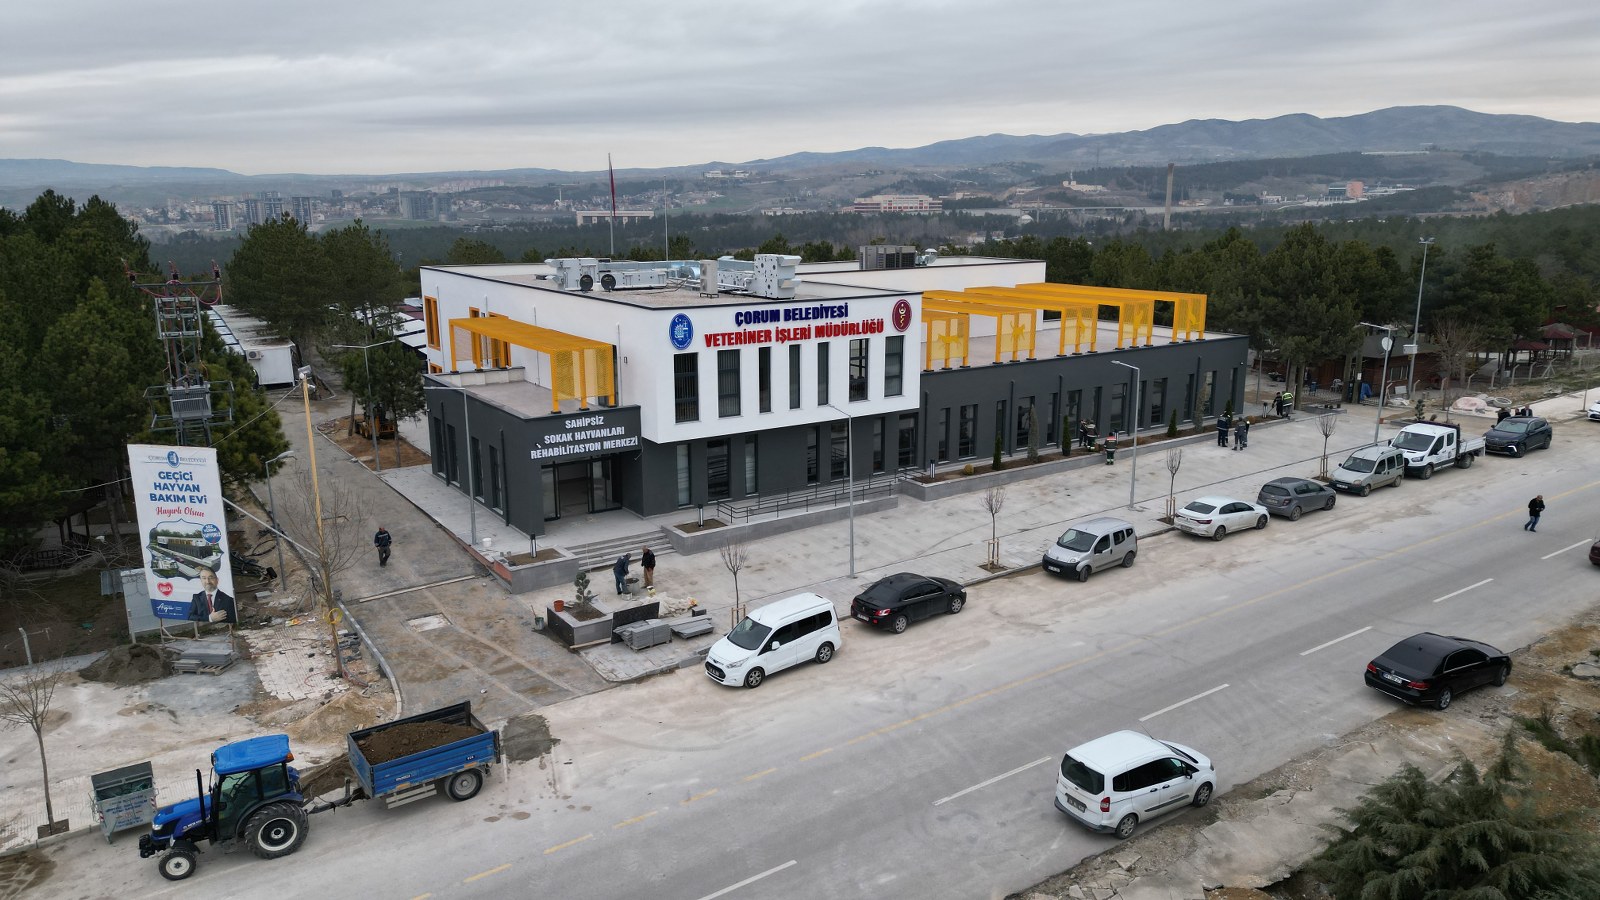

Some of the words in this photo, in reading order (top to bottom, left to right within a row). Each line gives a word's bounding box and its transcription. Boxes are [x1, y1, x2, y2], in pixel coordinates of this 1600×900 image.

[735, 309, 780, 327] ÇORUM
[784, 302, 849, 321] BELEDİYESİ
[704, 329, 772, 347] VETERİNER
[775, 324, 812, 344] İŞLERİ
[815, 318, 884, 338] MÜDÜRLÜĞÜ
[565, 415, 604, 429] SAHİPSİZ
[544, 432, 573, 444] SOKAK
[574, 426, 625, 440] HAYVANLARI
[530, 442, 601, 459] REHABİLİTASYON
[603, 436, 638, 449] MERKEZİ
[153, 482, 200, 492] HAYVAN
[150, 493, 186, 503] BAKIM
